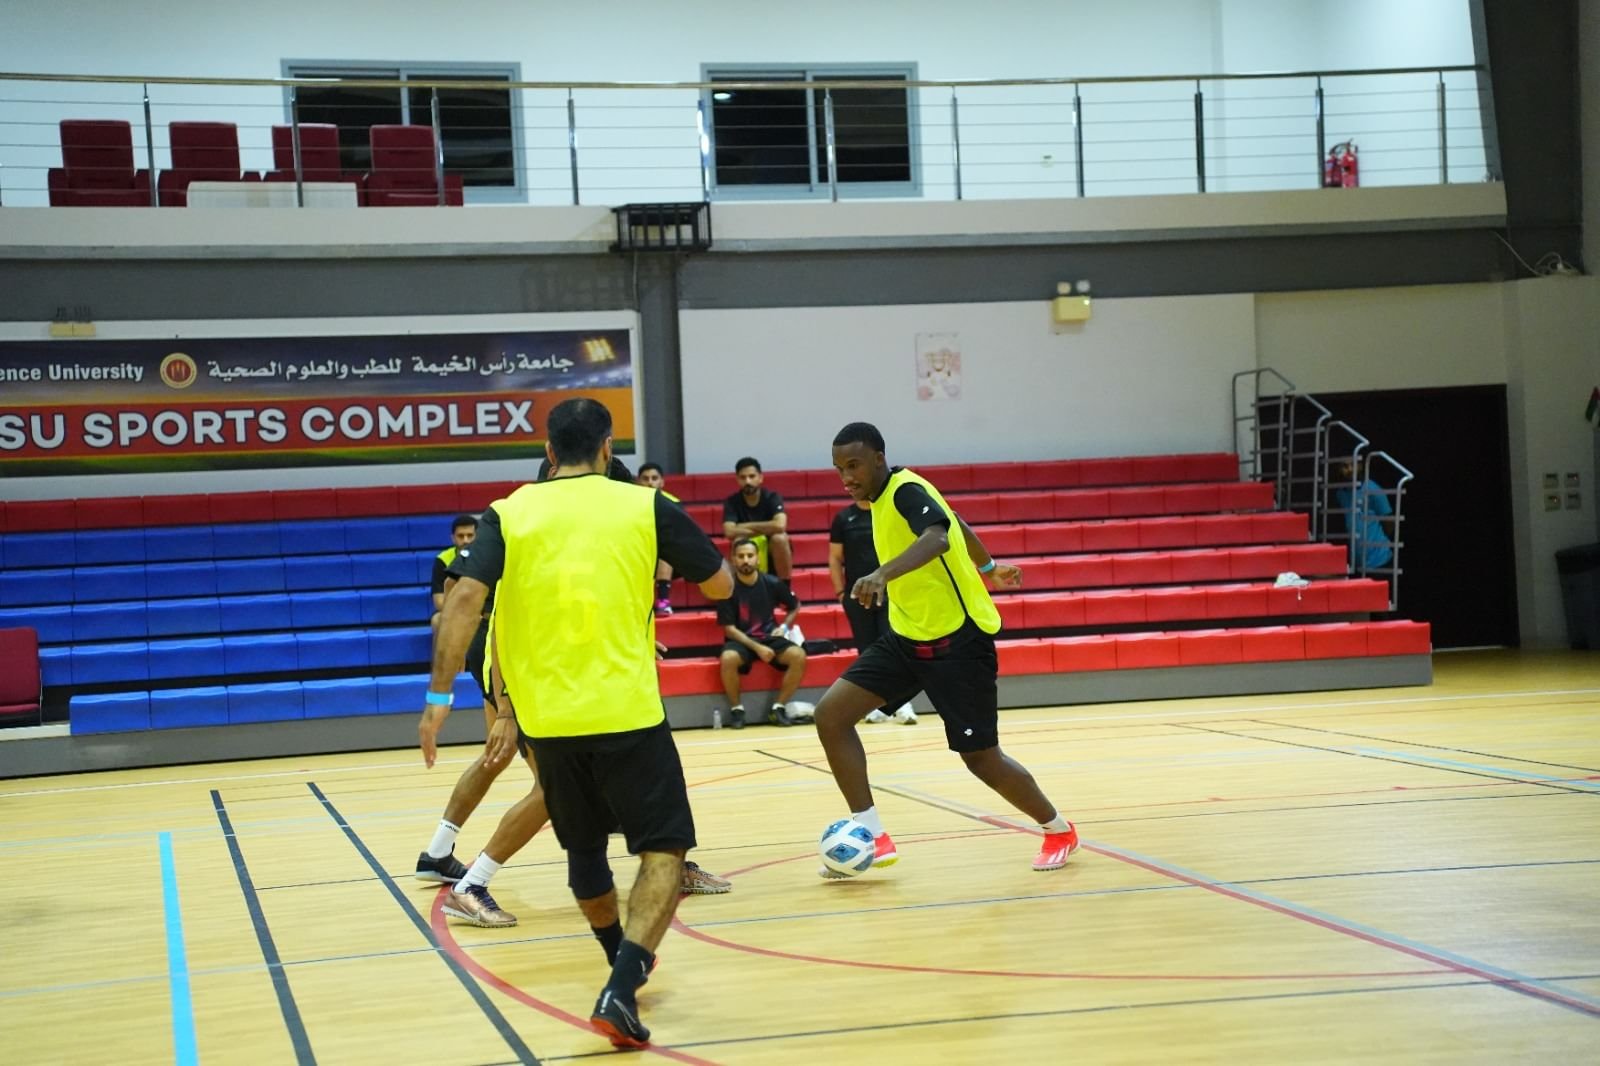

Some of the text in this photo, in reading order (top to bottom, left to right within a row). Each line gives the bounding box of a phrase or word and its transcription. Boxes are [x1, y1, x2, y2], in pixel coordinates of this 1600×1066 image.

[48, 363, 144, 382] University
[207, 352, 574, 382] جامعة رأس الخيمة للطب والعلوم الصحية
[0, 400, 534, 450] SU SPORTS COMPLEX
[559, 561, 600, 645] 5
